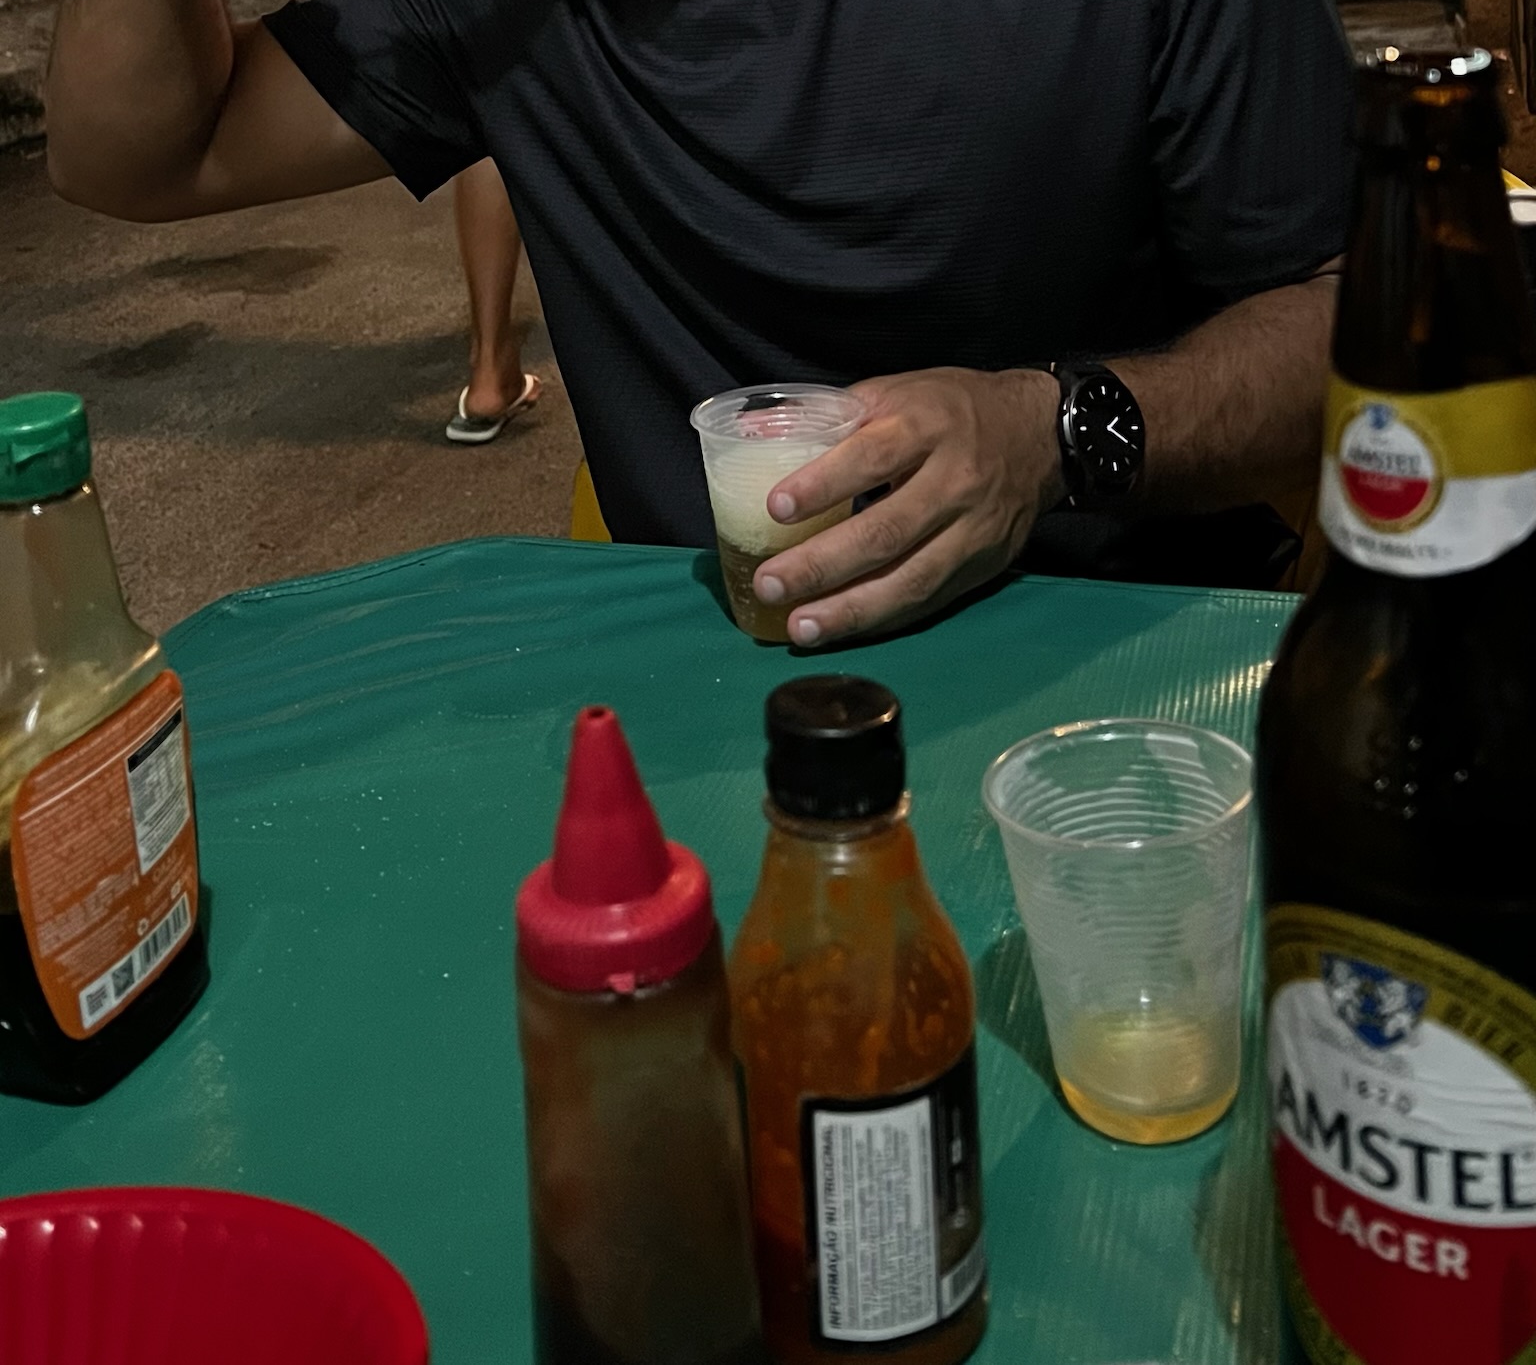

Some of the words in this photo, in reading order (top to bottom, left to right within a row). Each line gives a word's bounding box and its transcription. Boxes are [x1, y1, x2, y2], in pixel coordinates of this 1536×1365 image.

[1277, 1068, 1536, 1212] AMSTEL
[821, 1232, 842, 1330] INFORMAÇÃO
[1312, 1184, 1469, 1281] LAGER
